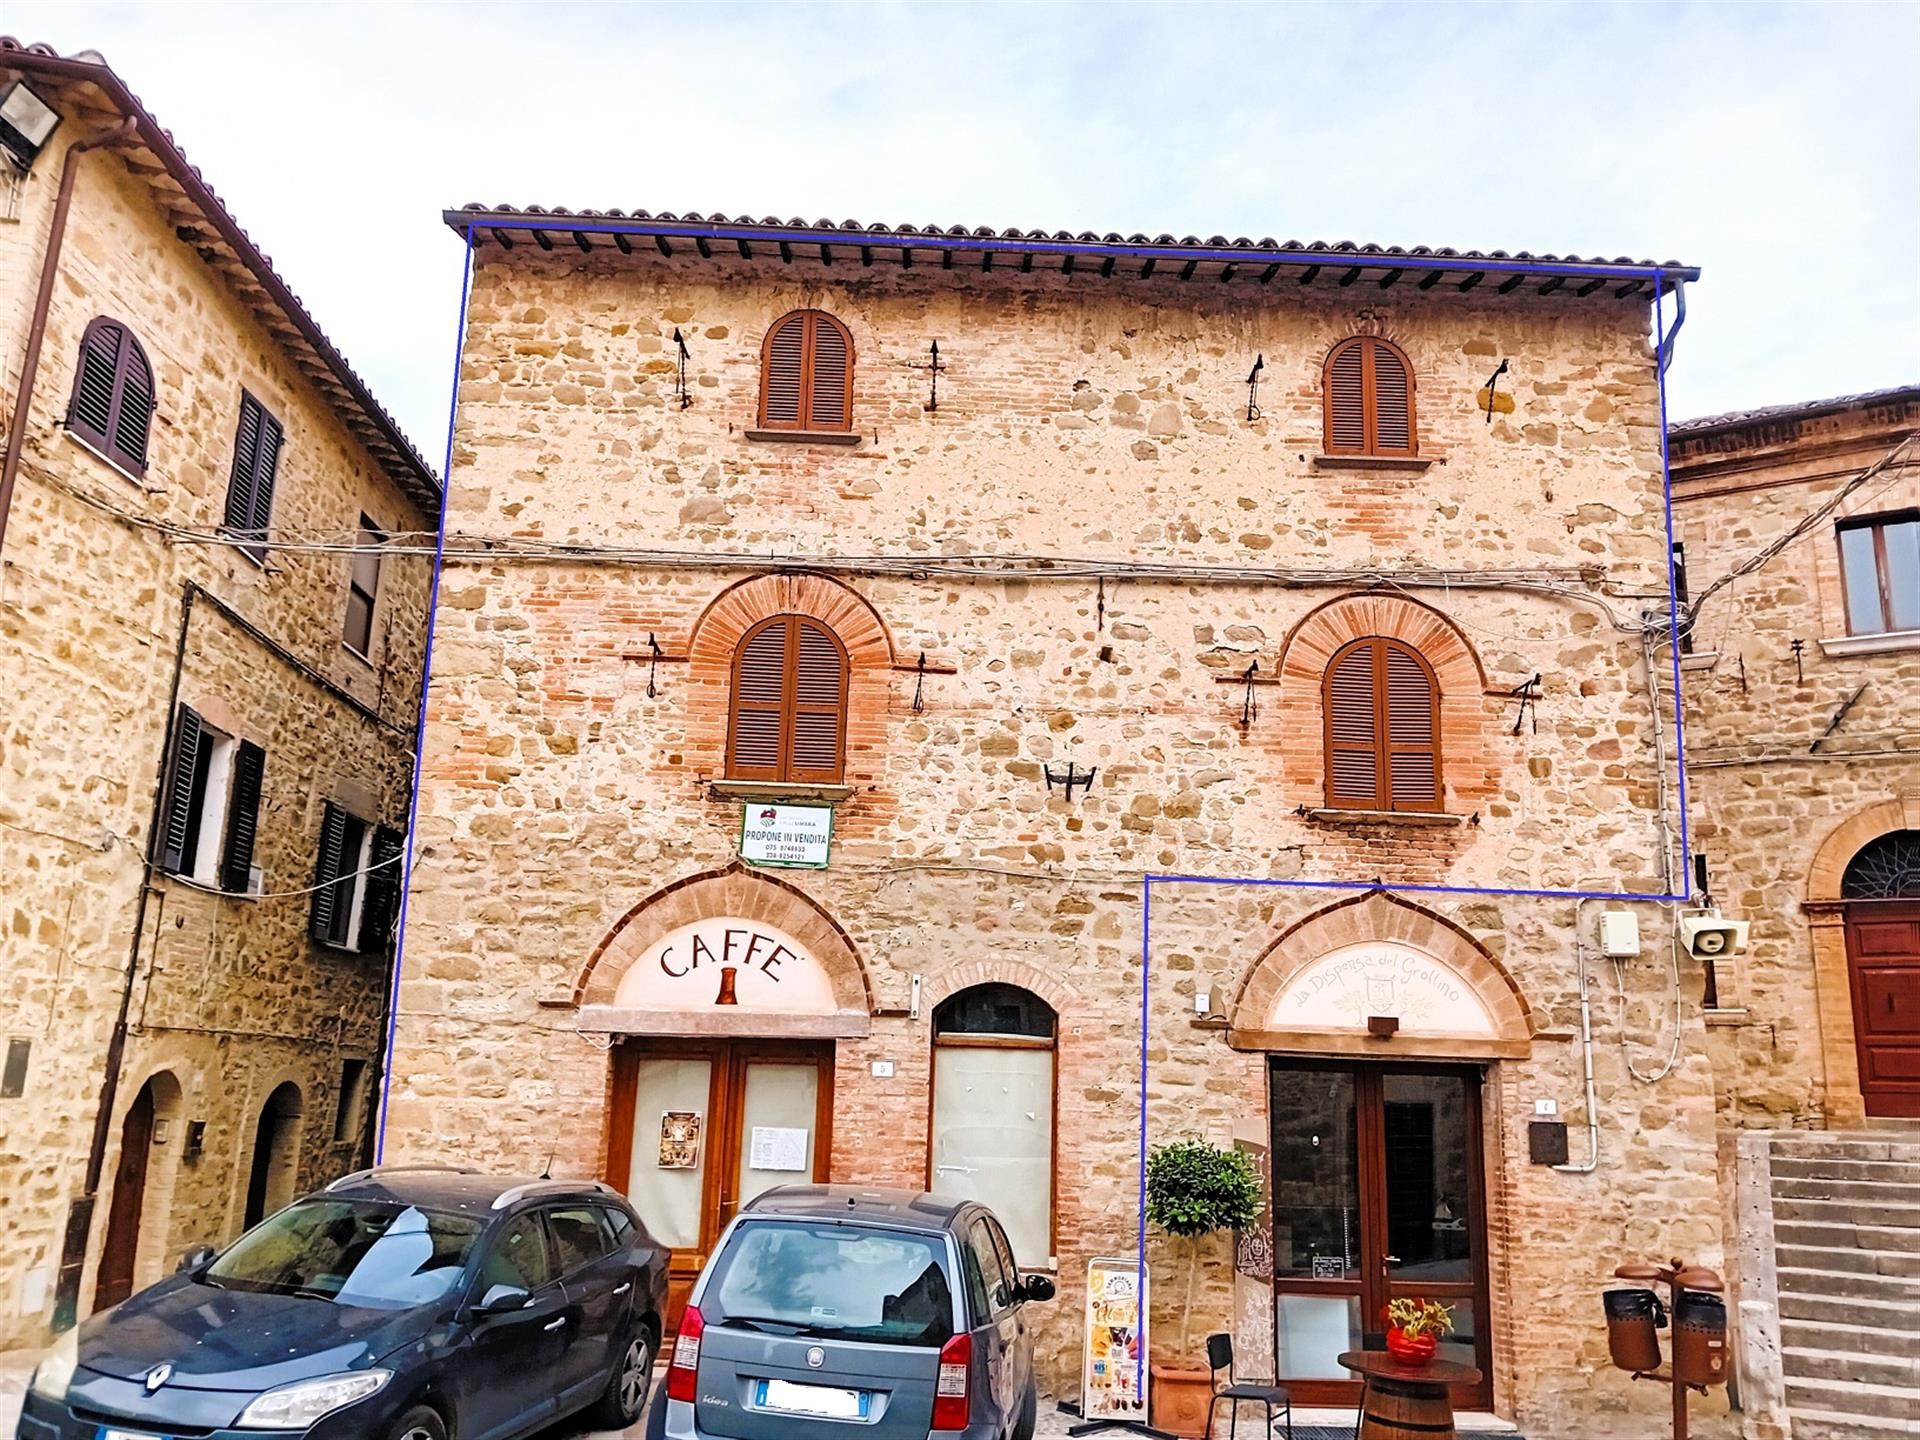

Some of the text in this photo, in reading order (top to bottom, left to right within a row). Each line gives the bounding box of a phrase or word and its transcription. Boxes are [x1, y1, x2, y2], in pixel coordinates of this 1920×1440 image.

[745, 830, 826, 844] PROPONE IN VENDITA
[1309, 956, 1378, 993] Dispensa
[1378, 951, 1398, 967] del
[880, 1065, 886, 1073] 5
[702, 1394, 729, 1406] idea
